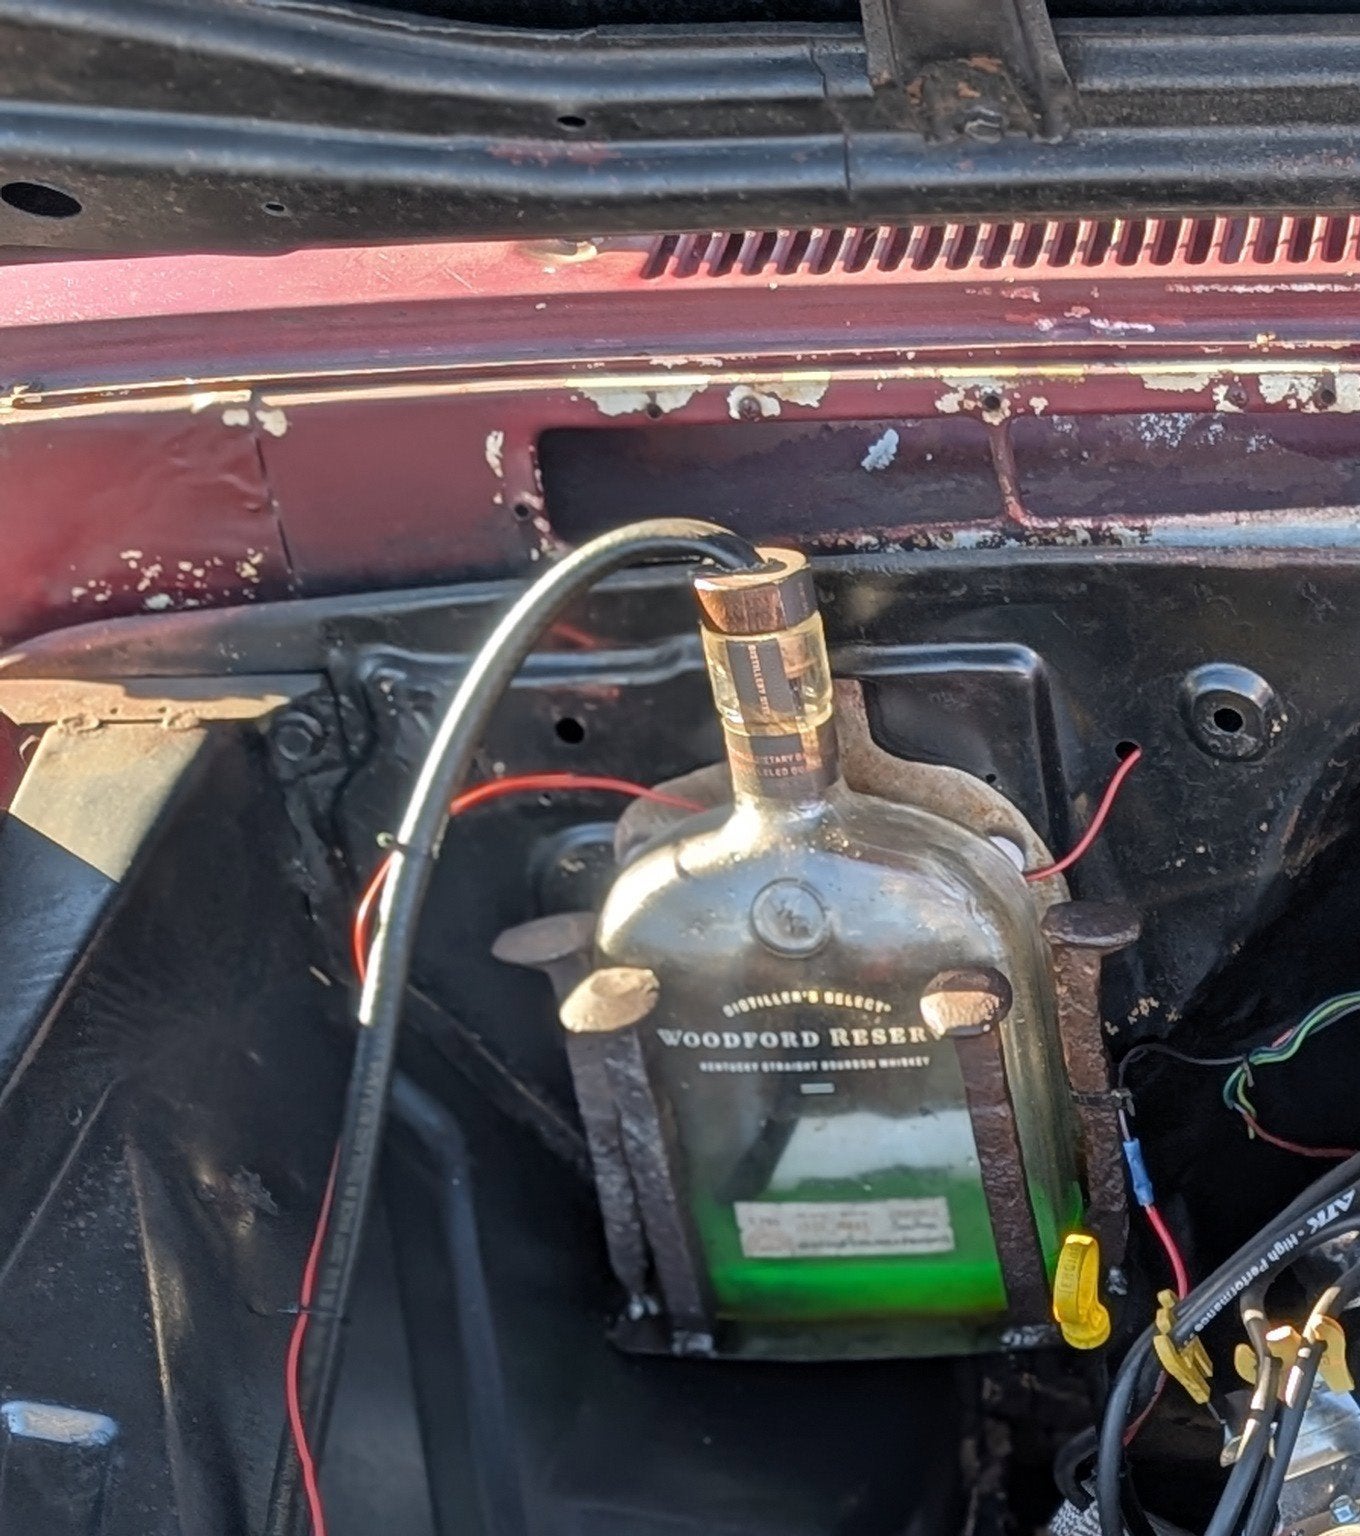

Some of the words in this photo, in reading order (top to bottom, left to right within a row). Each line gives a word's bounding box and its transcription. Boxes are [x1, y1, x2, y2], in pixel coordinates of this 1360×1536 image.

[656, 1027, 821, 1049] WOODFORD
[828, 1026, 942, 1048] RESER
[1306, 1188, 1357, 1235] ATK
[1271, 1232, 1300, 1263] High
[1193, 1253, 1272, 1334] Performance
